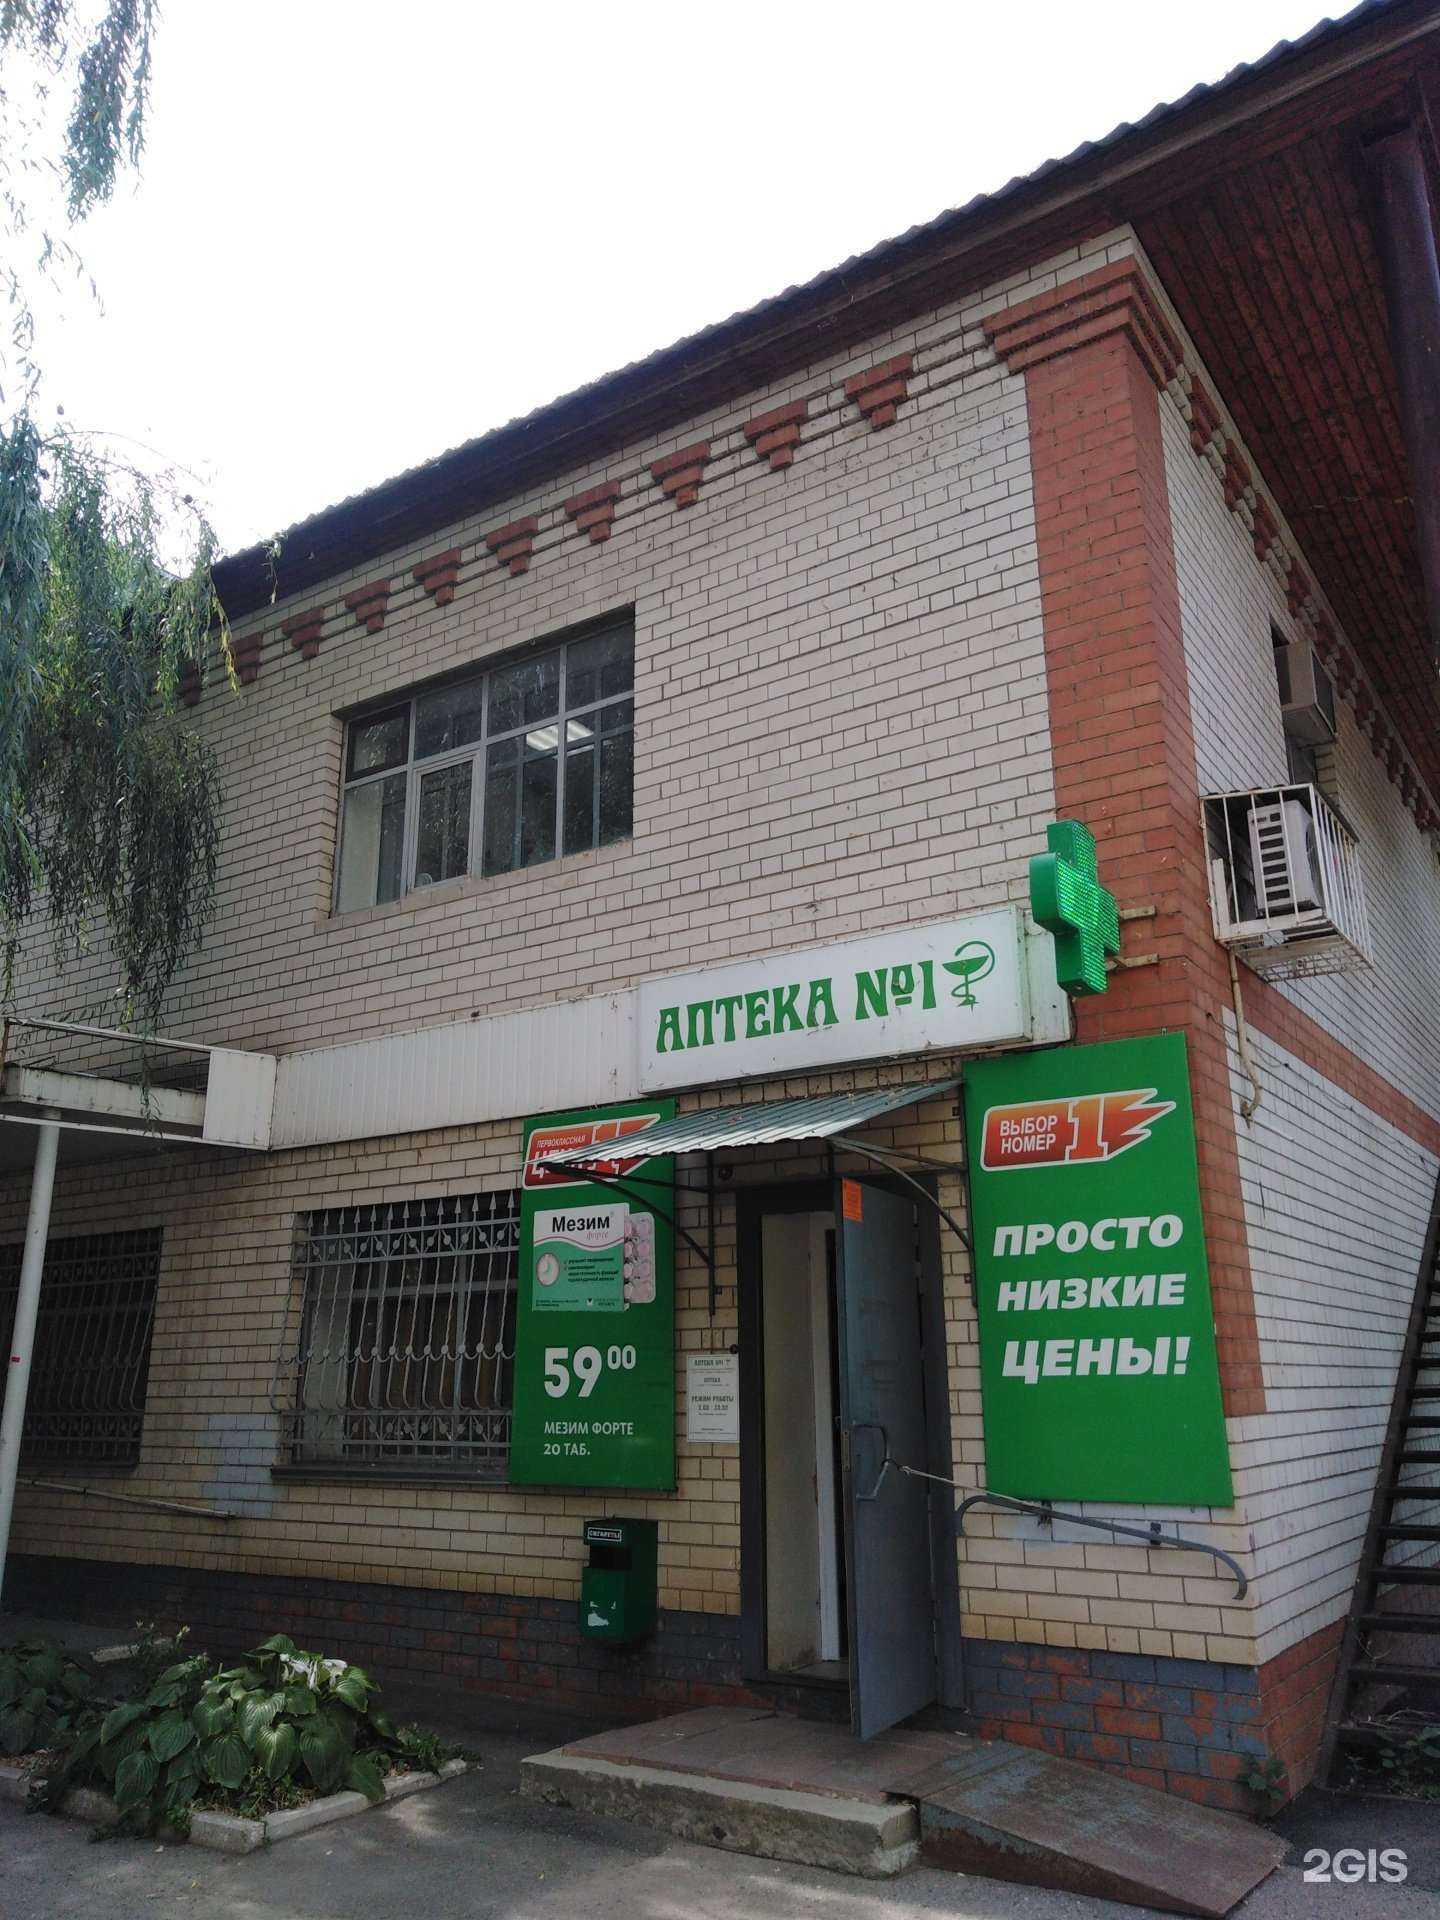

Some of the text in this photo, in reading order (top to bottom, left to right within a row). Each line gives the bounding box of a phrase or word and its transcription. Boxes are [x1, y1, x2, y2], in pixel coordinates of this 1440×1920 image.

[656, 960, 936, 1053] АПТЕКА №1
[1000, 1115, 1058, 1137] ВЫБОР
[1001, 1134, 1056, 1154] НОМЕР
[552, 1216, 610, 1232] Мезим
[993, 1214, 1184, 1257] ПРОСТО
[997, 1273, 1186, 1312] НИЗКИЕ
[544, 1345, 636, 1398] 59 00
[1002, 1336, 1191, 1384] ЦЕНЫ!
[544, 1422, 634, 1435] МЕЗИМ ФОРТЕ
[544, 1443, 591, 1456] 20 ТАБ.
